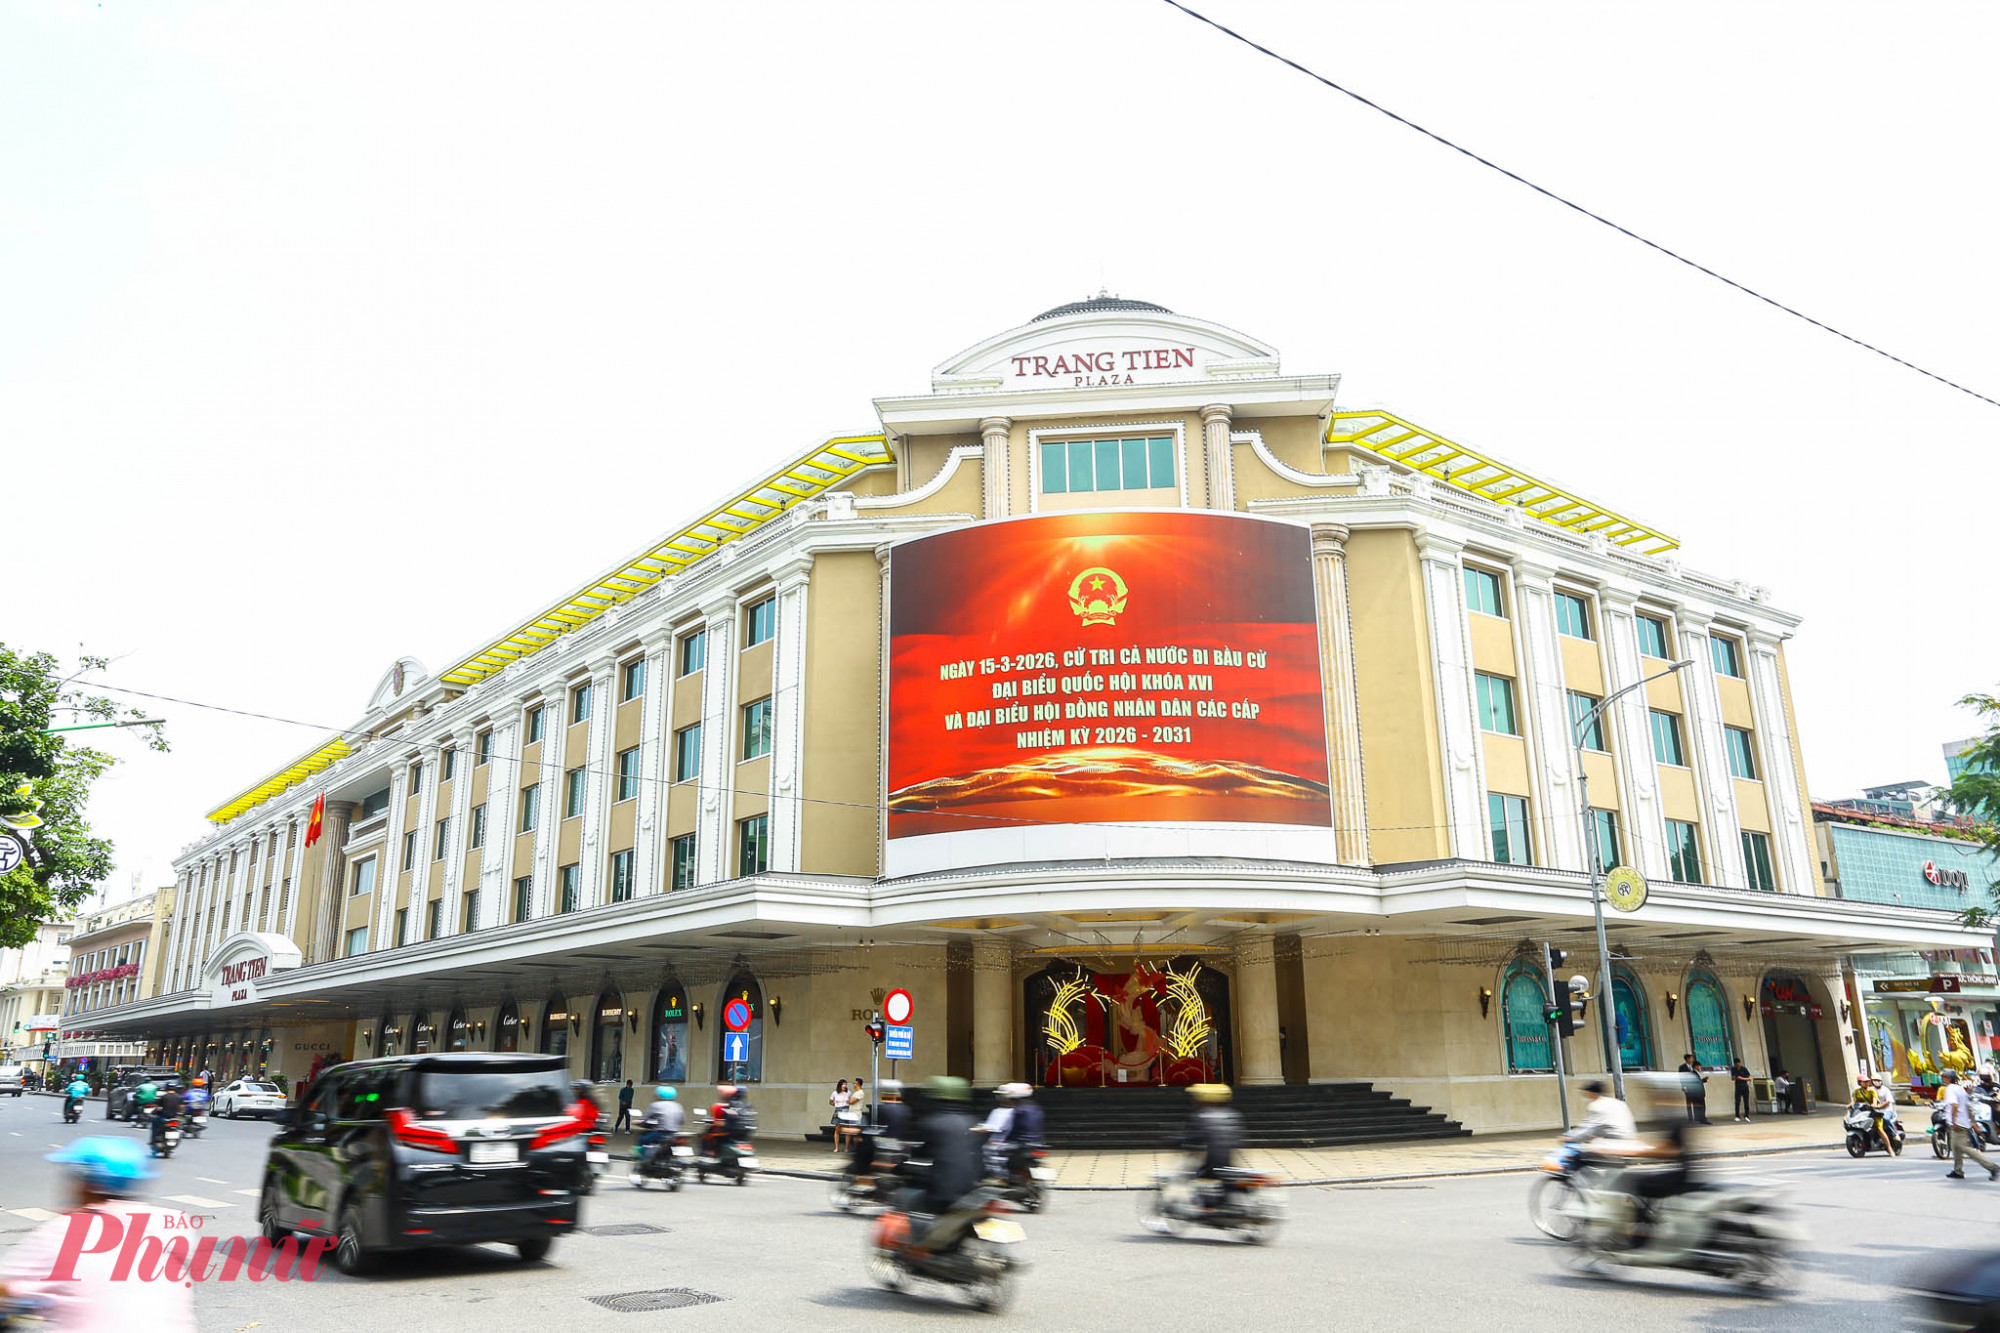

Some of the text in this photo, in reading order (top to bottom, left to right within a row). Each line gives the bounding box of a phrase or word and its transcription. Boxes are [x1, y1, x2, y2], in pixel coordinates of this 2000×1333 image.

[1011, 347, 1195, 378] TRANG TIEN
[1074, 373, 1135, 387] PLAZA
[940, 644, 1268, 681] NGÀY 15-3-2026, CỬ TRI CẢ NƯỚC ĐI BẦU CỬ
[992, 670, 1214, 701] ĐẠI BIỂU QUỐC HỘI KHÓA XVI
[945, 697, 1261, 731] VÀ ĐẠI BIỂU HỘI ĐỒNG NHÂN DÂN CÁC CẤP
[1016, 727, 1065, 750] NHIỆM
[1070, 726, 1091, 745] KỲ
[1095, 726, 1137, 744] 2026
[1152, 726, 1192, 743] 2031
[221, 955, 268, 988] TRANG TIEN
[1942, 979, 1952, 990] P
[665, 1009, 682, 1018] ROLEX
[294, 1042, 331, 1051] GUCCI
